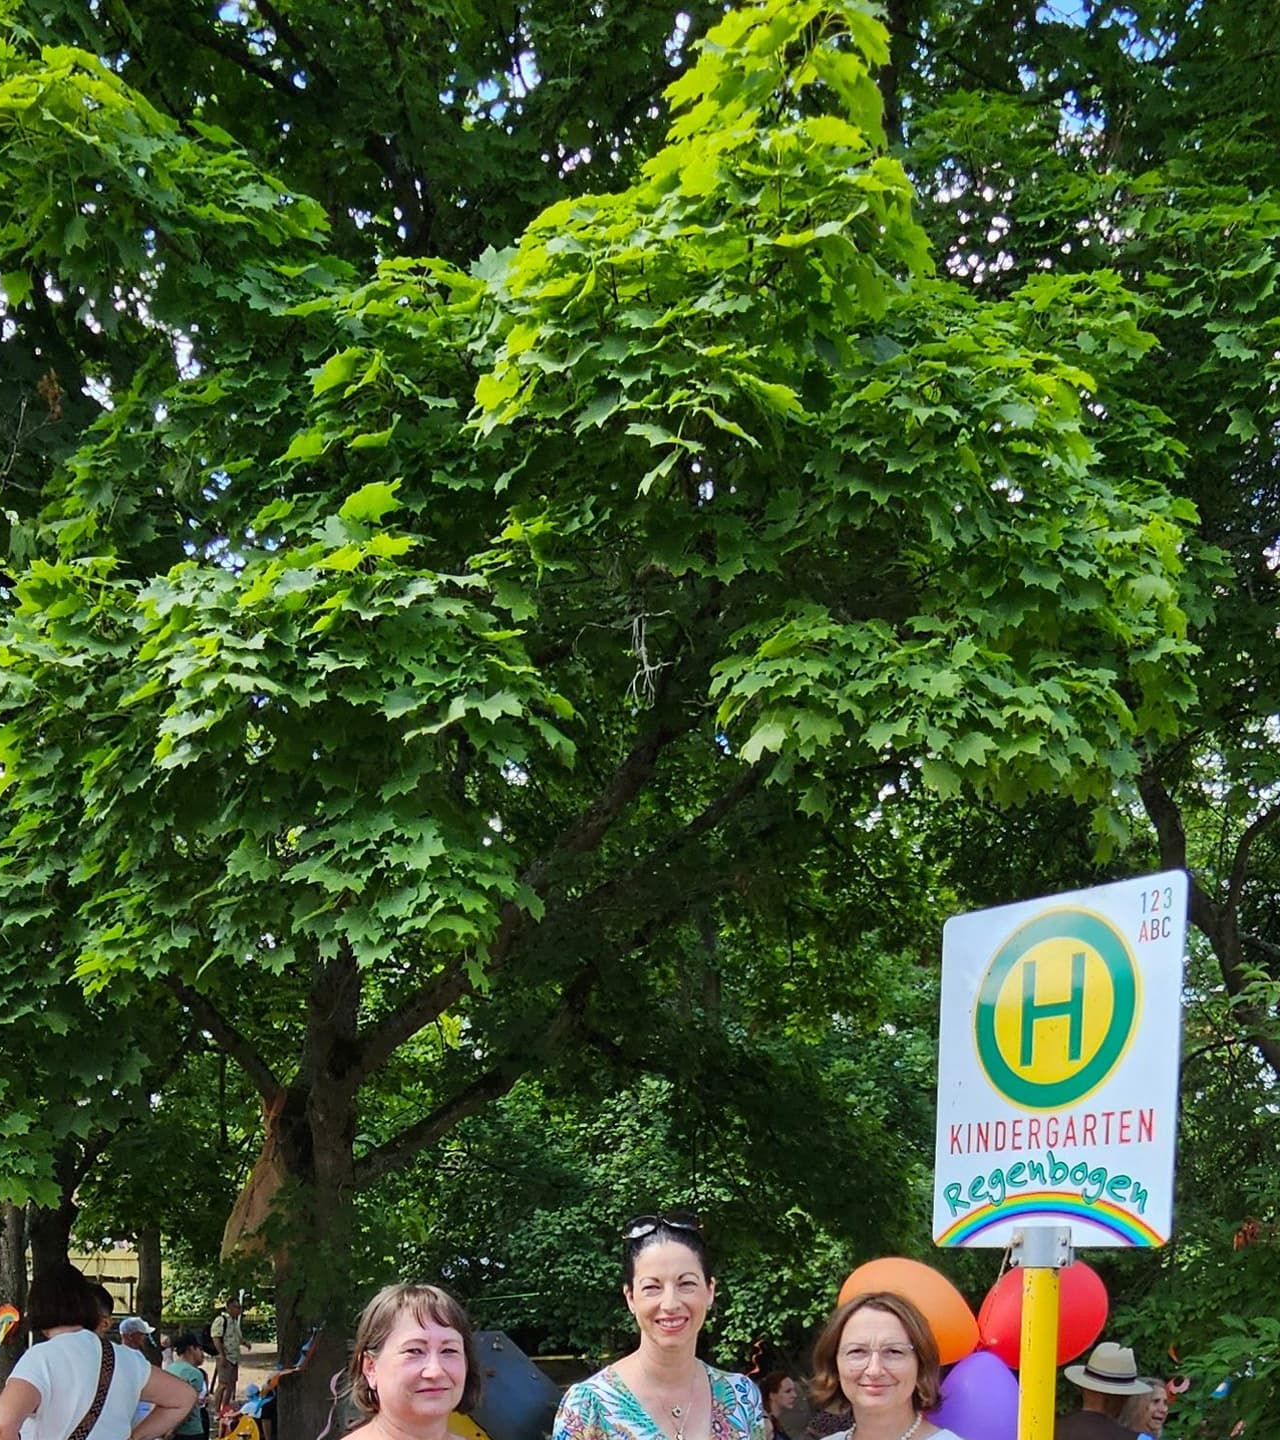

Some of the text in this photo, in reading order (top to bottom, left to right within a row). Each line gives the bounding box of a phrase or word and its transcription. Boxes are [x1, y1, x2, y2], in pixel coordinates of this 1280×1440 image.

[1140, 887, 1173, 914] 123
[1138, 916, 1171, 943] ABC
[1020, 952, 1085, 1067] H
[949, 1108, 1155, 1155] KINDERGARTEN
[943, 1150, 1149, 1218] Regenbogen
